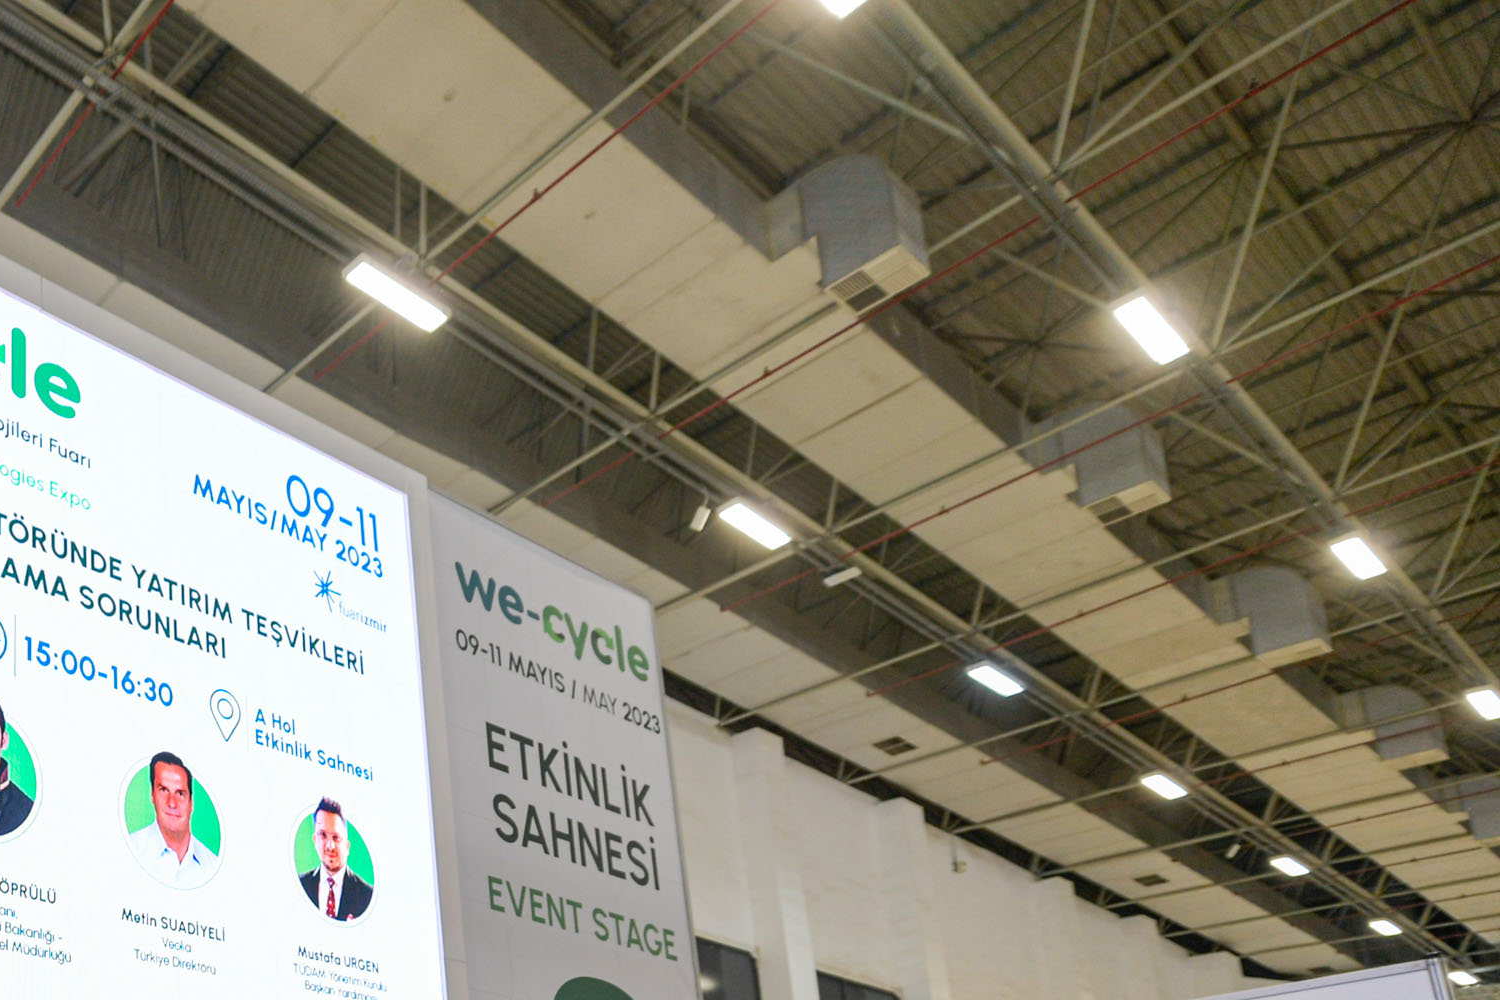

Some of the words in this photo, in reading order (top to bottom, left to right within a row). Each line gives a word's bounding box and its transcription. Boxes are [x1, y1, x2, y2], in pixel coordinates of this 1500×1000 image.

[48, 436, 92, 470] Fuarı
[48, 481, 92, 516] Expo
[285, 473, 381, 553] 09-11
[334, 539, 385, 579] 2023
[79, 584, 228, 660] SORUNLARI
[131, 564, 234, 625] YATIRIM
[241, 606, 366, 676] TEŞVİKLERİ
[454, 560, 650, 682] we-cycle
[23, 635, 175, 707] 15:00-16:30
[454, 628, 503, 668] 09-11
[508, 651, 566, 695] MAYIS
[582, 683, 619, 716] MAY
[621, 701, 662, 735] 2023
[254, 708, 267, 725] A
[271, 710, 296, 736] Hol
[254, 728, 313, 764] Etkinlik
[317, 749, 374, 783] Sahnesi
[485, 721, 656, 827] ETKİNLİK
[491, 793, 661, 891] SAHNESİ
[121, 907, 157, 928] Metin
[487, 875, 583, 934] EVENT
[592, 907, 679, 962] STAGE
[297, 945, 341, 966] Mustafa
